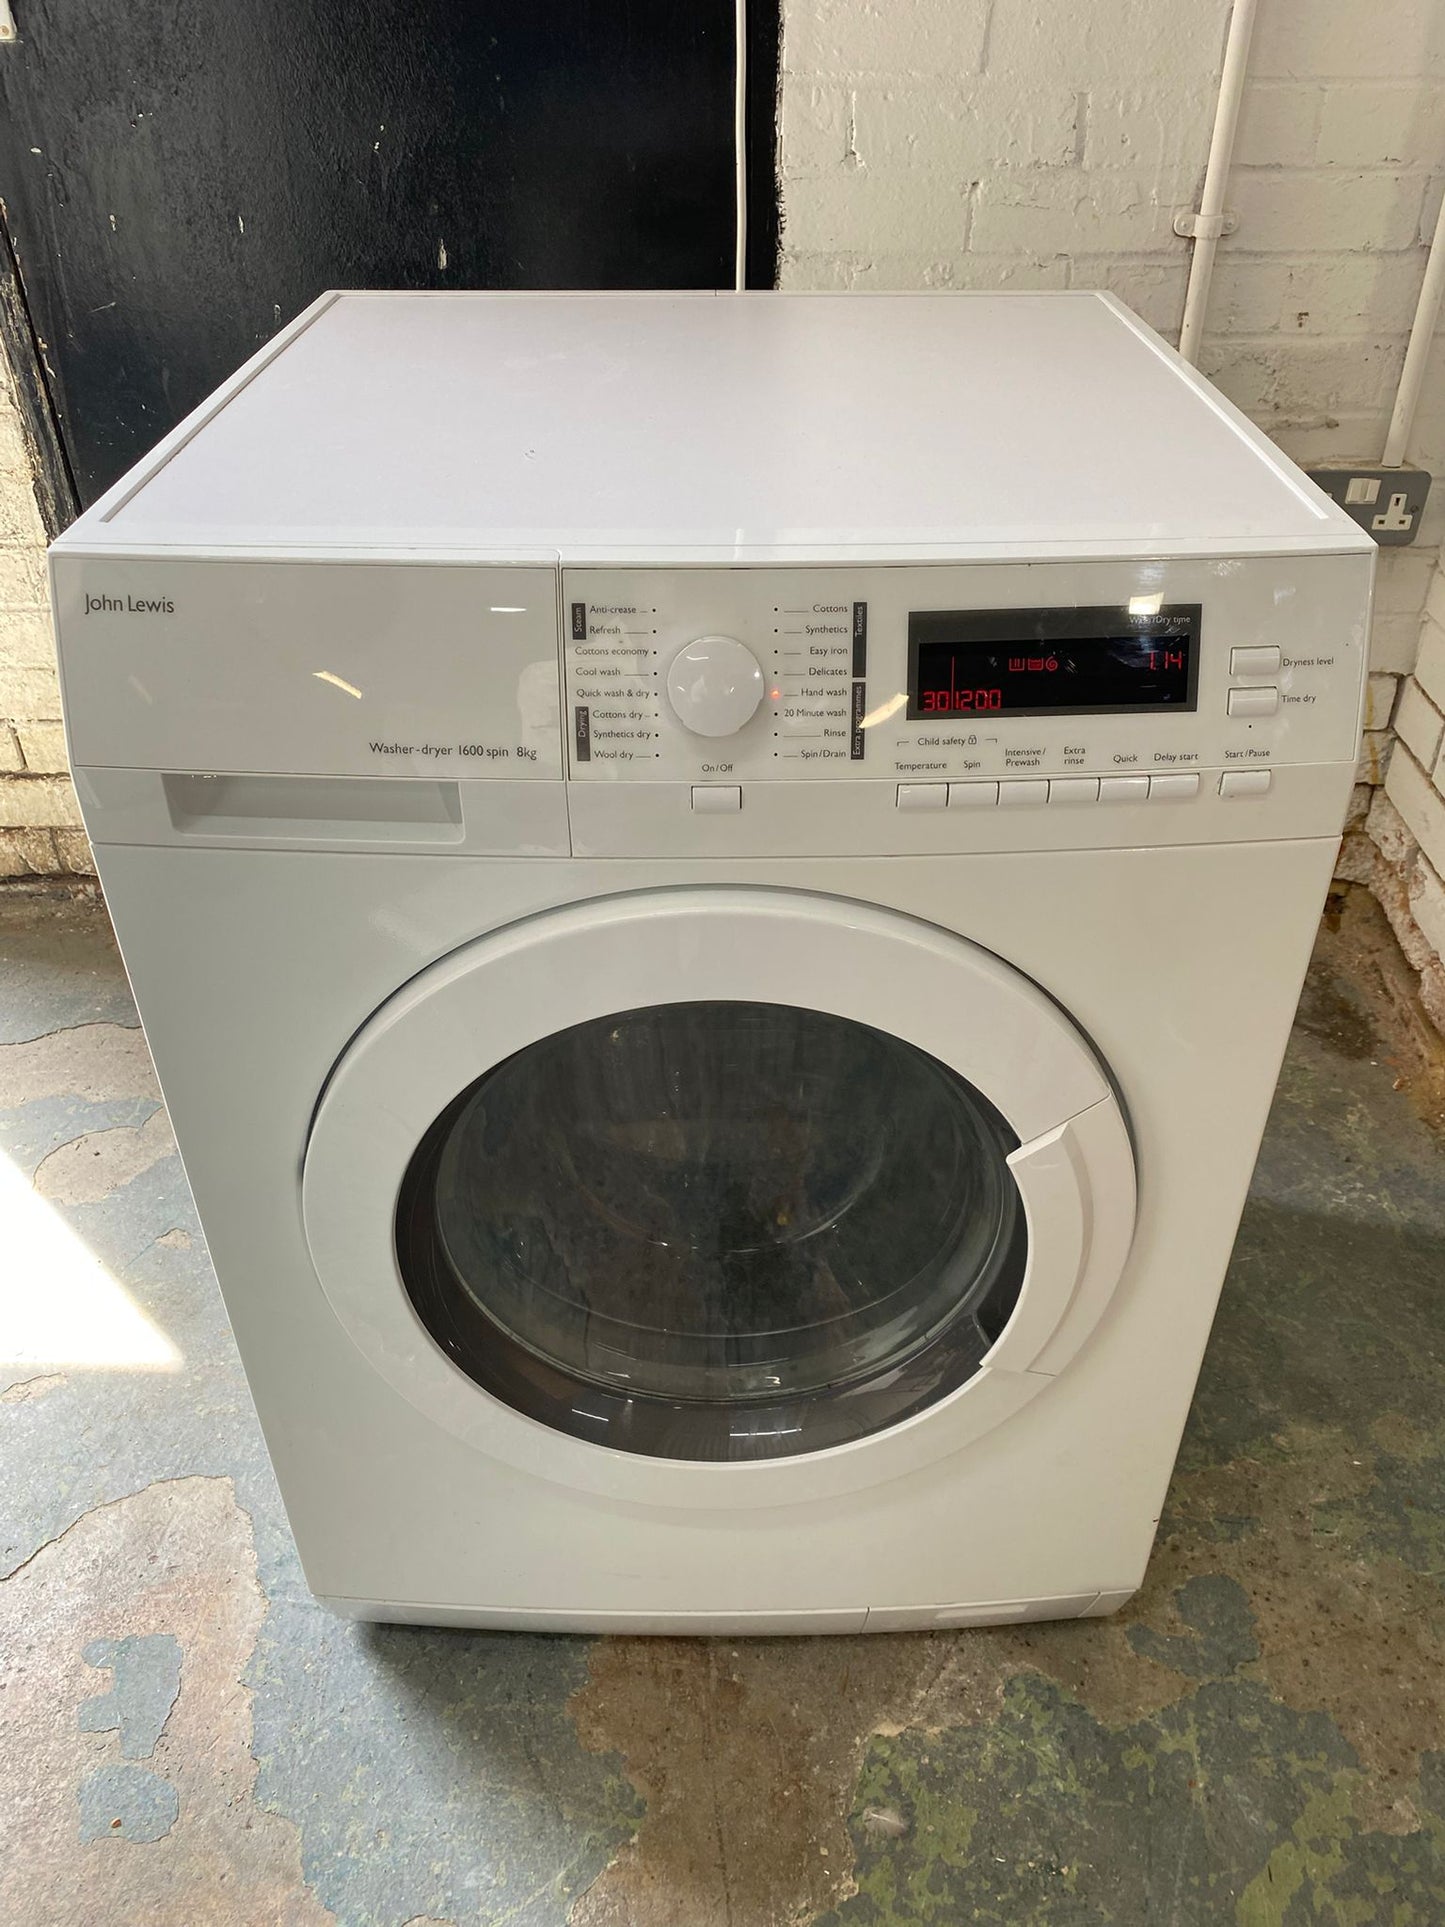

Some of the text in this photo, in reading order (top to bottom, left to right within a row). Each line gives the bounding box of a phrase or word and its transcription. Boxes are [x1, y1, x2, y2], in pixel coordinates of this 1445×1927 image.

[85, 594, 174, 614] John Lewis
[813, 605, 848, 613] Cottons
[574, 607, 582, 632] Steam
[855, 606, 863, 636] Textiles
[590, 626, 621, 634] Refresh
[805, 625, 848, 634] Synthetics
[575, 647, 609, 655] Cottons
[810, 647, 827, 656] Easy
[1283, 657, 1334, 668] Dryness level
[576, 668, 621, 676] Cool wash
[809, 667, 847, 676] Delicates
[577, 689, 650, 698] Quick wash & dry
[801, 688, 847, 696] Hand wash
[923, 689, 1001, 712] 30 1200
[1282, 695, 1316, 704] Time dry
[593, 710, 643, 720] Cottons dry
[796, 709, 824, 717] Minute
[827, 709, 847, 717] wash
[578, 711, 587, 738] Drying
[594, 731, 651, 740] Synthetics dry
[824, 729, 846, 737] Rinse
[853, 735, 861, 756] Extra
[918, 737, 965, 747] Child safety
[369, 742, 537, 760] Washer-dryer 1600 spin 8kg
[801, 751, 846, 759] Spin/Drain
[1005, 748, 1046, 756] Intensive/
[1064, 747, 1085, 755] Extra
[1225, 749, 1270, 758] Start/Pause
[594, 751, 633, 761] Wool dry
[1113, 754, 1138, 763] Quick
[1154, 752, 1198, 763] Delay start
[964, 761, 981, 770] Spin
[1006, 758, 1040, 766] Prewash
[1064, 757, 1084, 765] rinse
[701, 764, 733, 772] On/Off
[895, 762, 947, 771] Temperature
